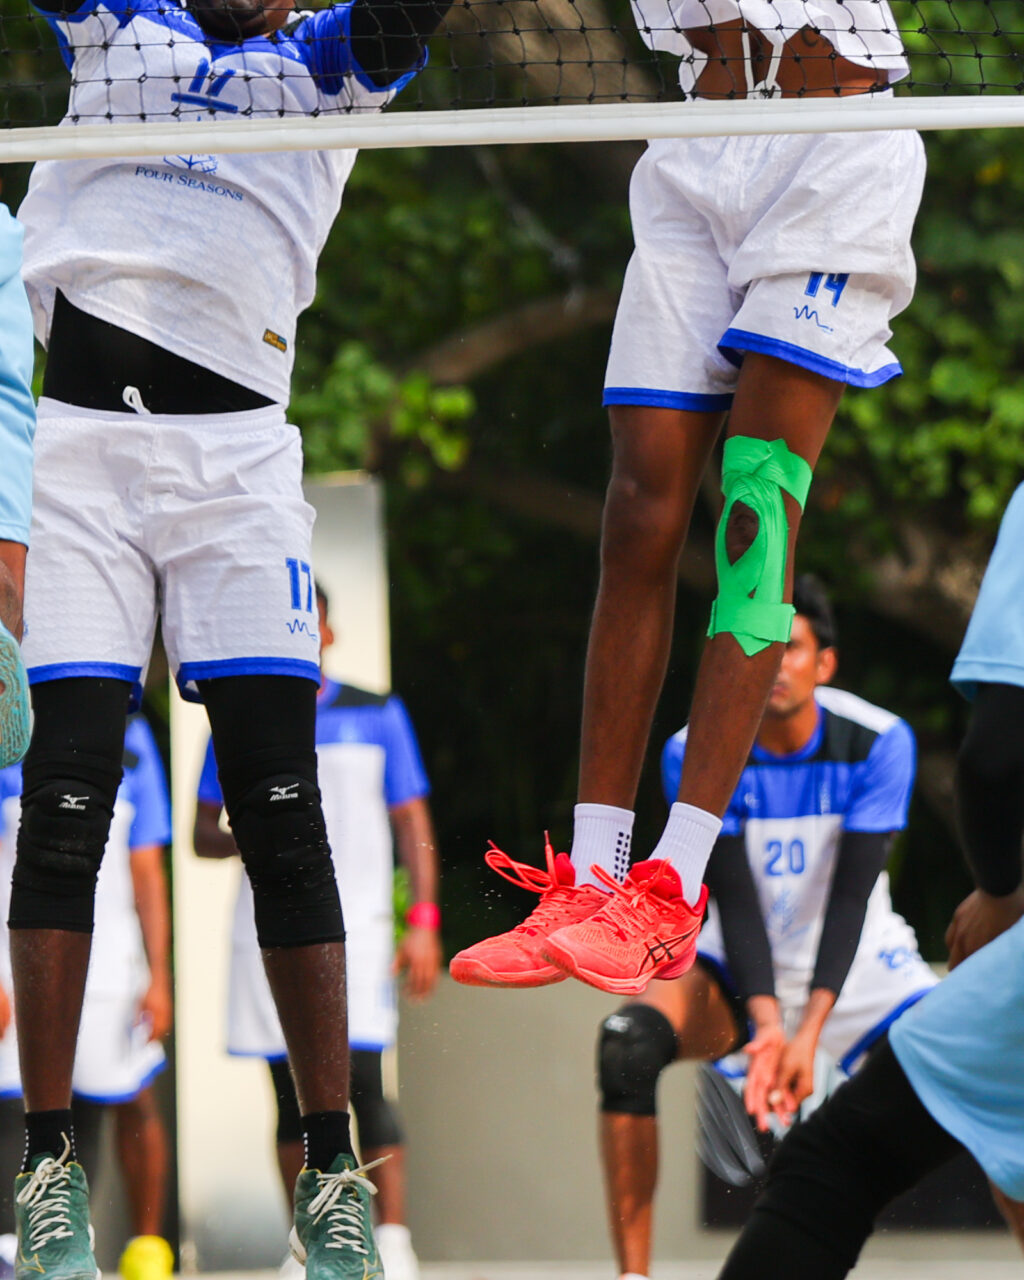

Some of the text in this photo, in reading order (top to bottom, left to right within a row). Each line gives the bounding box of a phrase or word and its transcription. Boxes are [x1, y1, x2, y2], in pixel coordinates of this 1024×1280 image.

[135, 166, 244, 201] FOUR SEASONS
[285, 557, 313, 614] 17
[764, 838, 805, 877] 20
